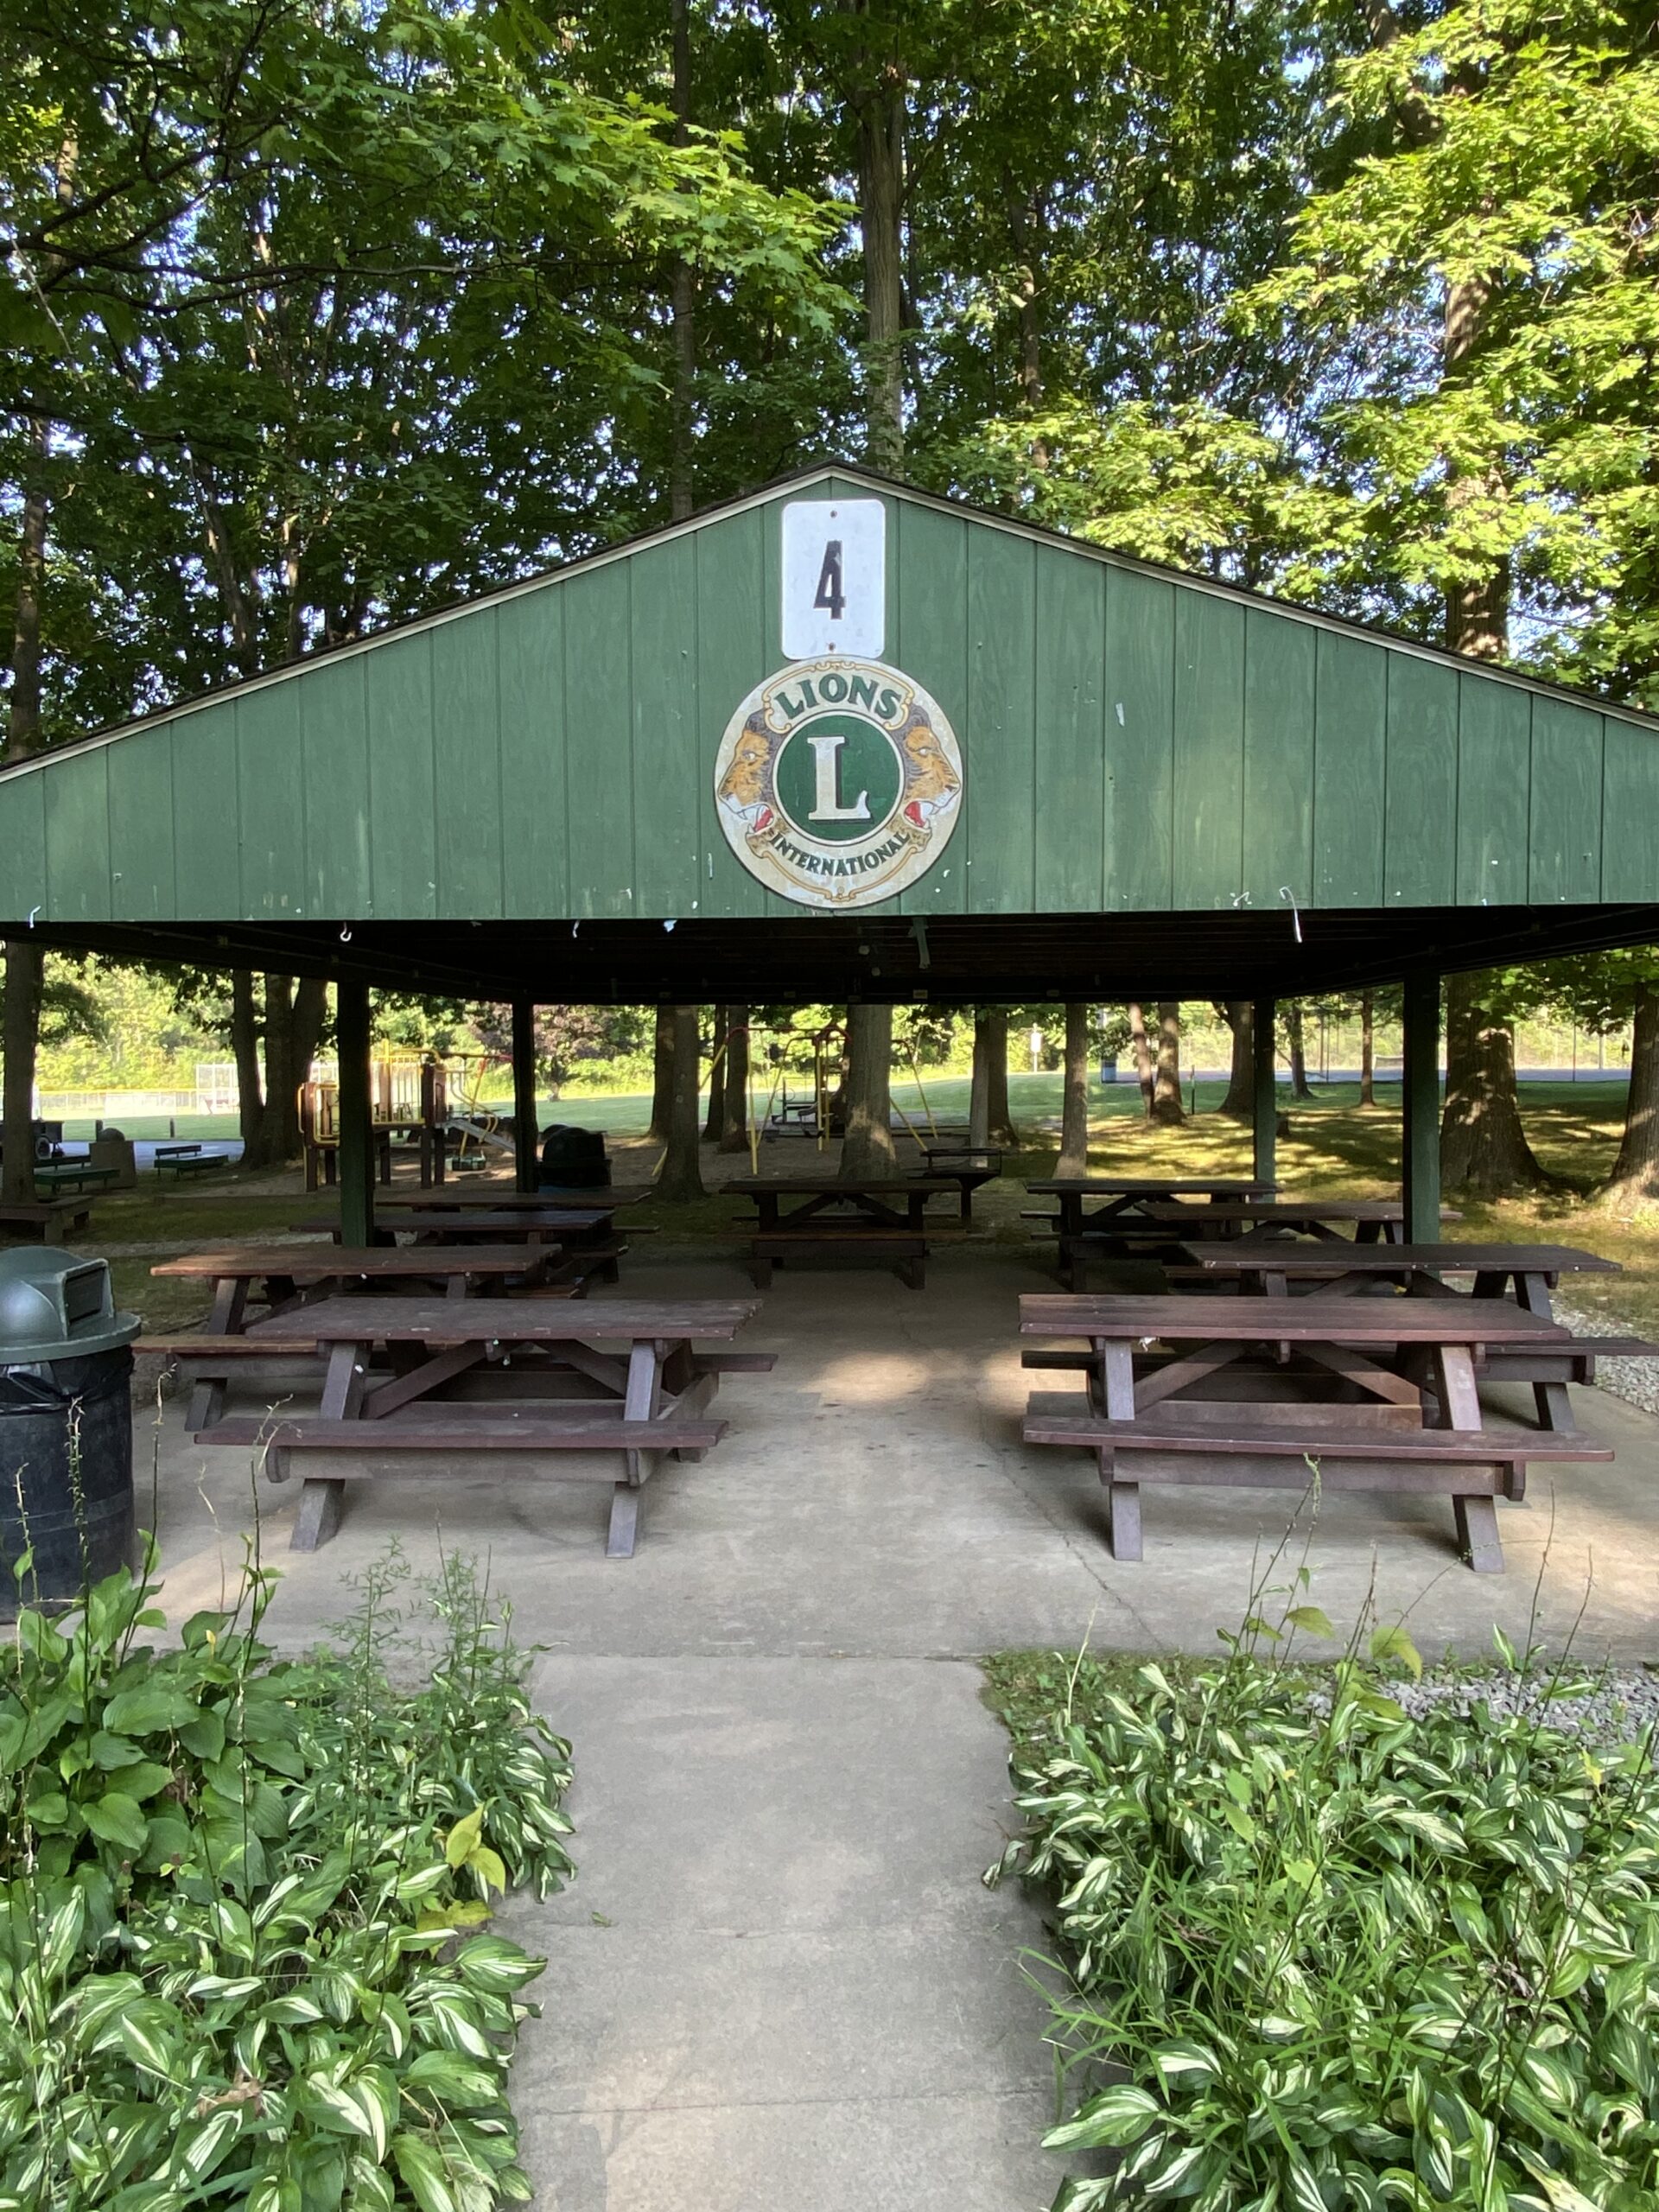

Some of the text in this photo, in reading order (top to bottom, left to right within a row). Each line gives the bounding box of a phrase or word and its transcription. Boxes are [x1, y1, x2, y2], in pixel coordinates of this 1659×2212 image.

[814, 540, 846, 620] 4
[774, 673, 901, 719] LIONS
[807, 736, 871, 820] L
[769, 831, 910, 876] INTERNATIONAL
